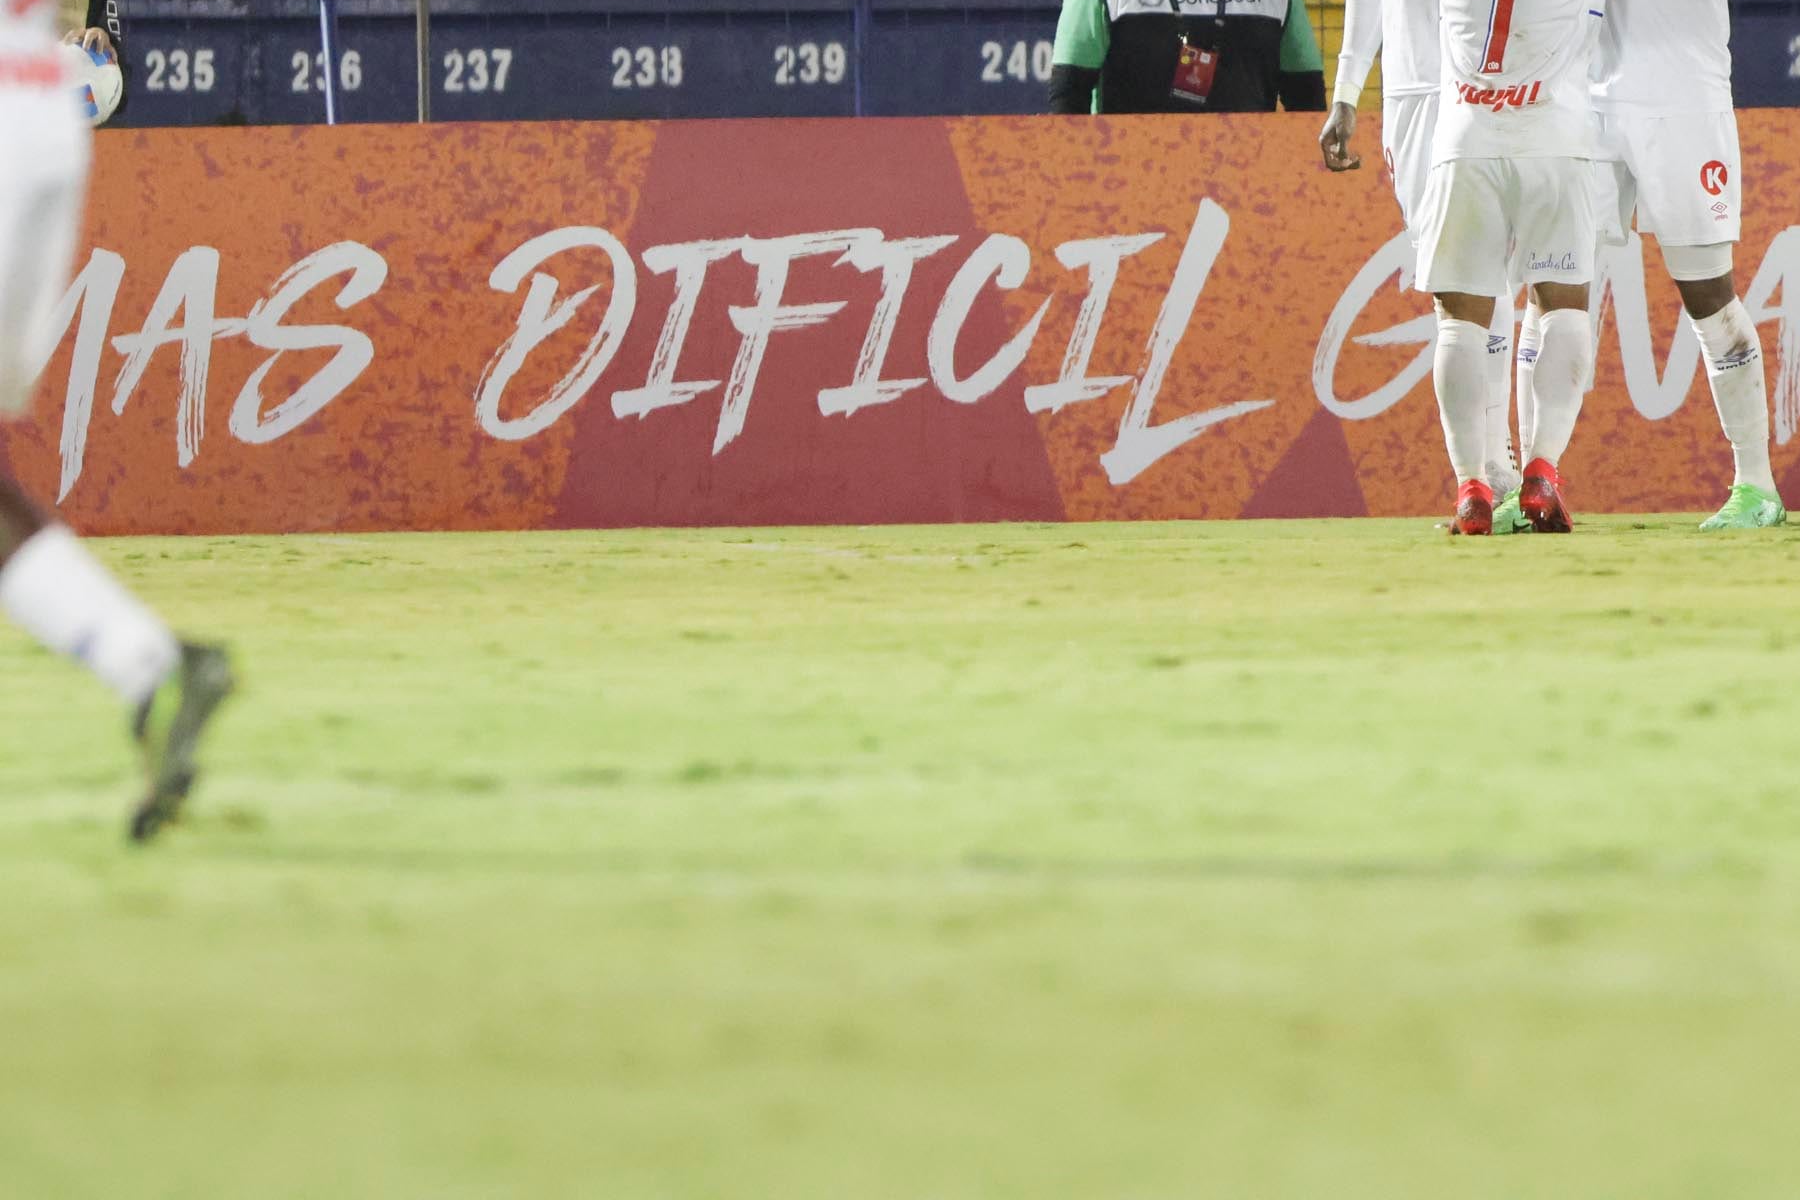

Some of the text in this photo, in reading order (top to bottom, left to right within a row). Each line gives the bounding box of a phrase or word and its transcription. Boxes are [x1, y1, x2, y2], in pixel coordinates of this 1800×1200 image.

[145, 48, 216, 92] 235
[443, 48, 513, 92] 237
[774, 41, 847, 85] 239
[475, 198, 1274, 485] DIFICIL
